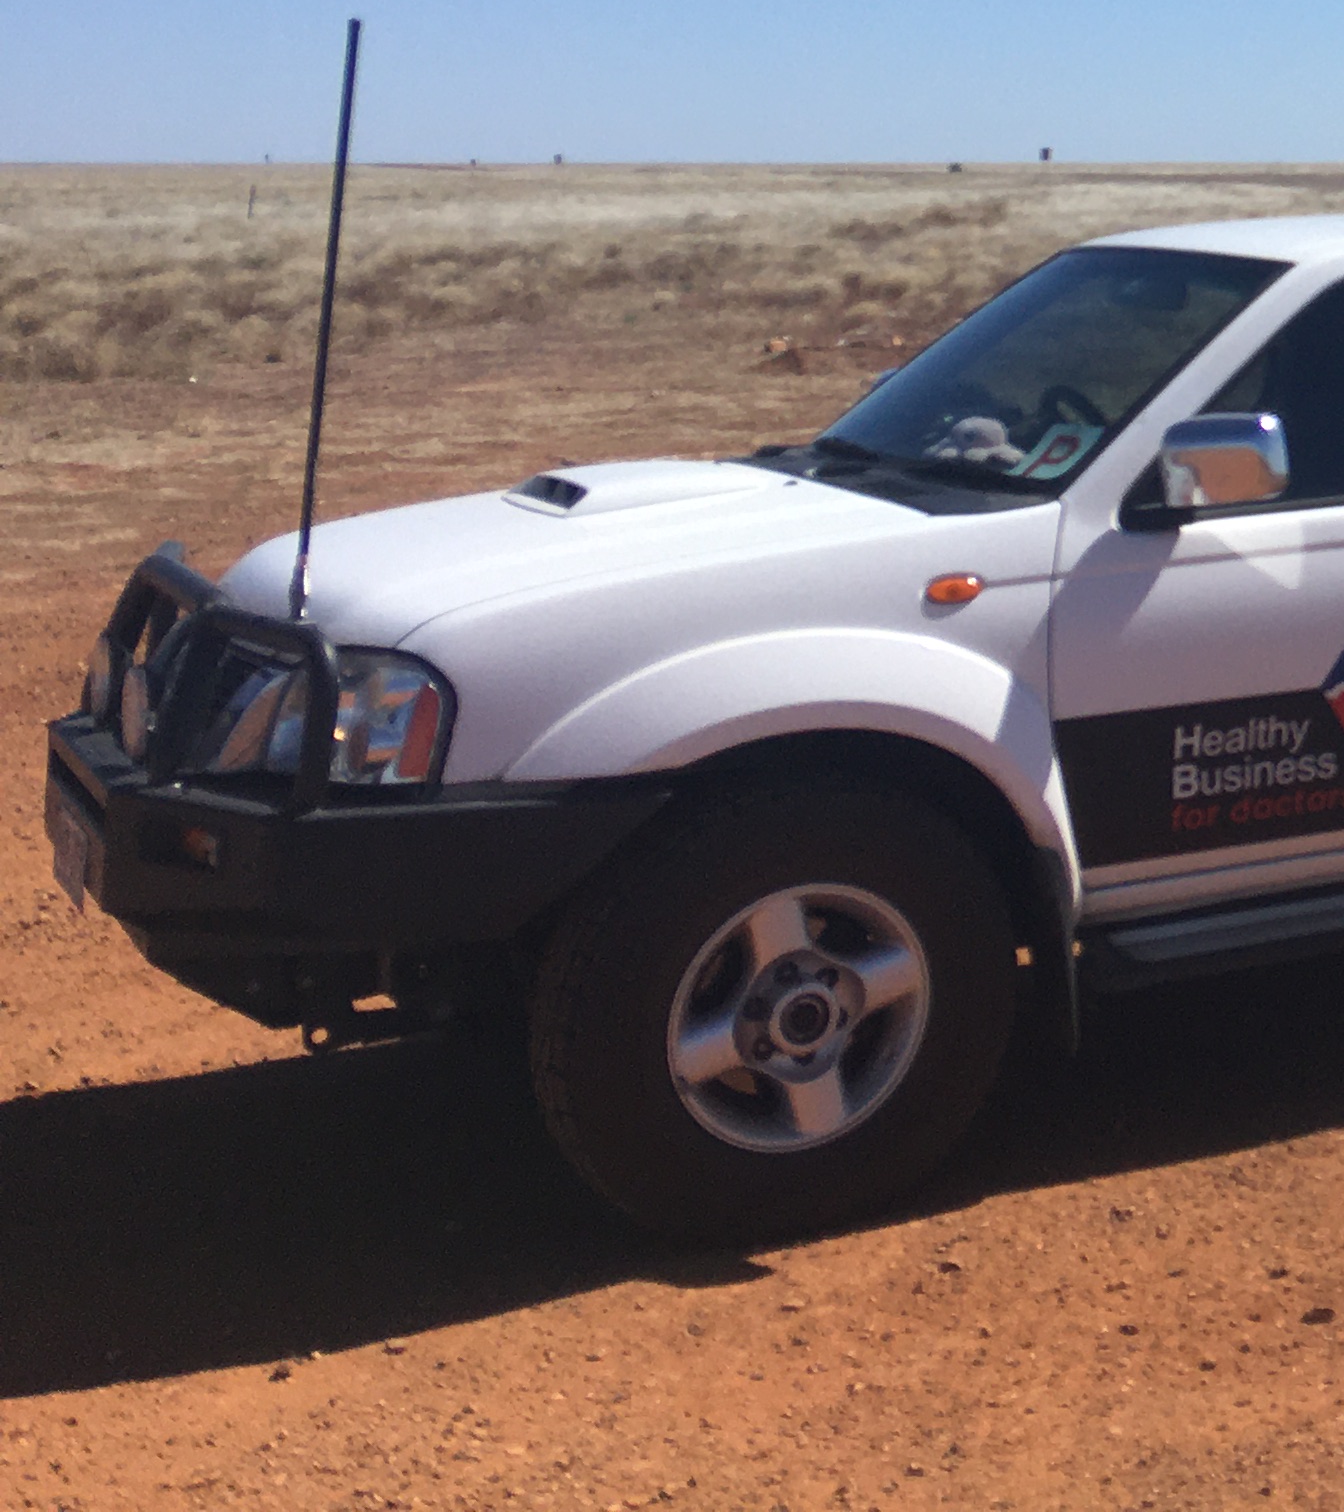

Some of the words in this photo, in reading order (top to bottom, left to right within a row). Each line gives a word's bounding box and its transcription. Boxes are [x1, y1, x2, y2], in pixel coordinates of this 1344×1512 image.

[1174, 715, 1311, 760] Healthy
[1173, 752, 1338, 800] Business
[1172, 802, 1221, 831] for
